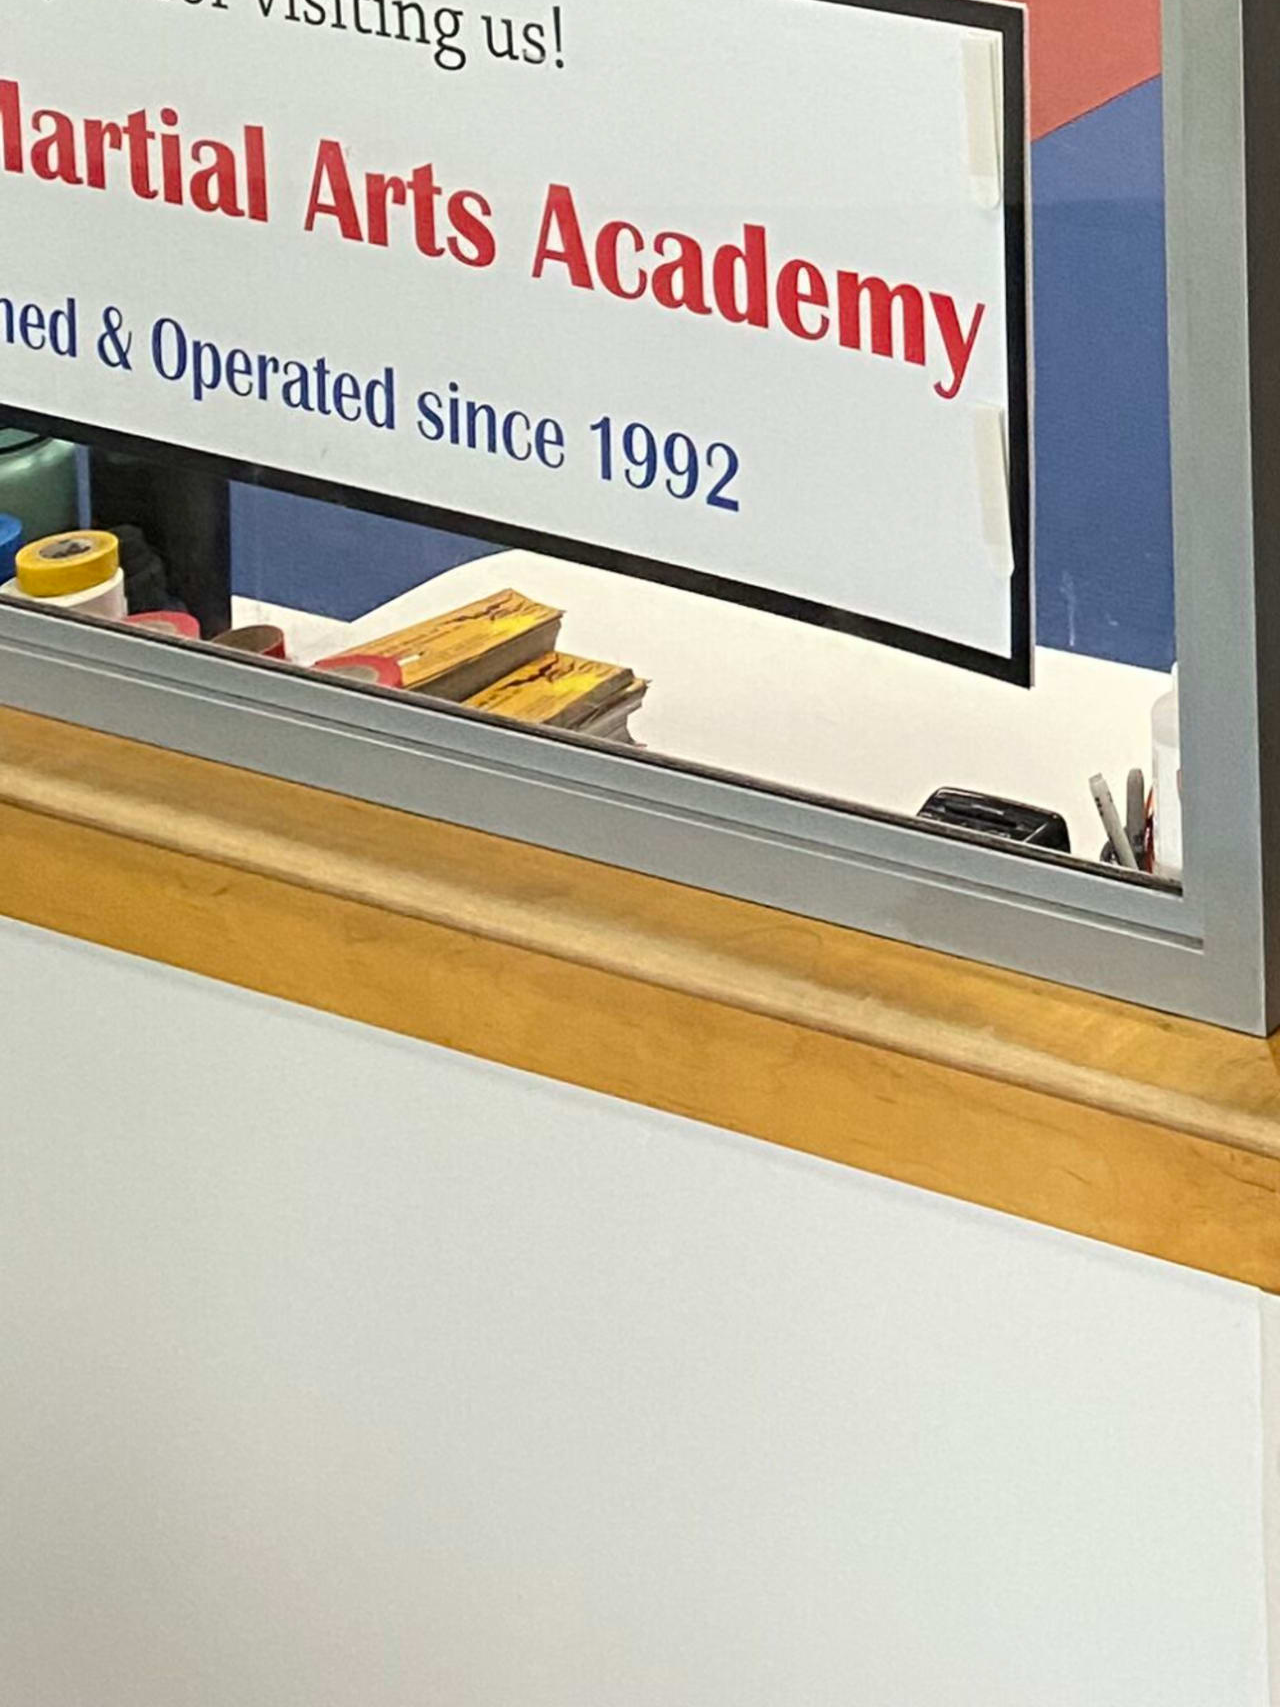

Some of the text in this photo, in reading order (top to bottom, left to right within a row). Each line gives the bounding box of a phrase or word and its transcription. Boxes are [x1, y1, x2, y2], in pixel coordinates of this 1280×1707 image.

[481, 6, 563, 68] us!
[305, 140, 495, 267] Arts
[532, 184, 985, 398] Academy
[98, 306, 131, 370] &
[152, 318, 394, 429] Operated
[418, 382, 564, 468] since
[591, 417, 739, 512] 1992
